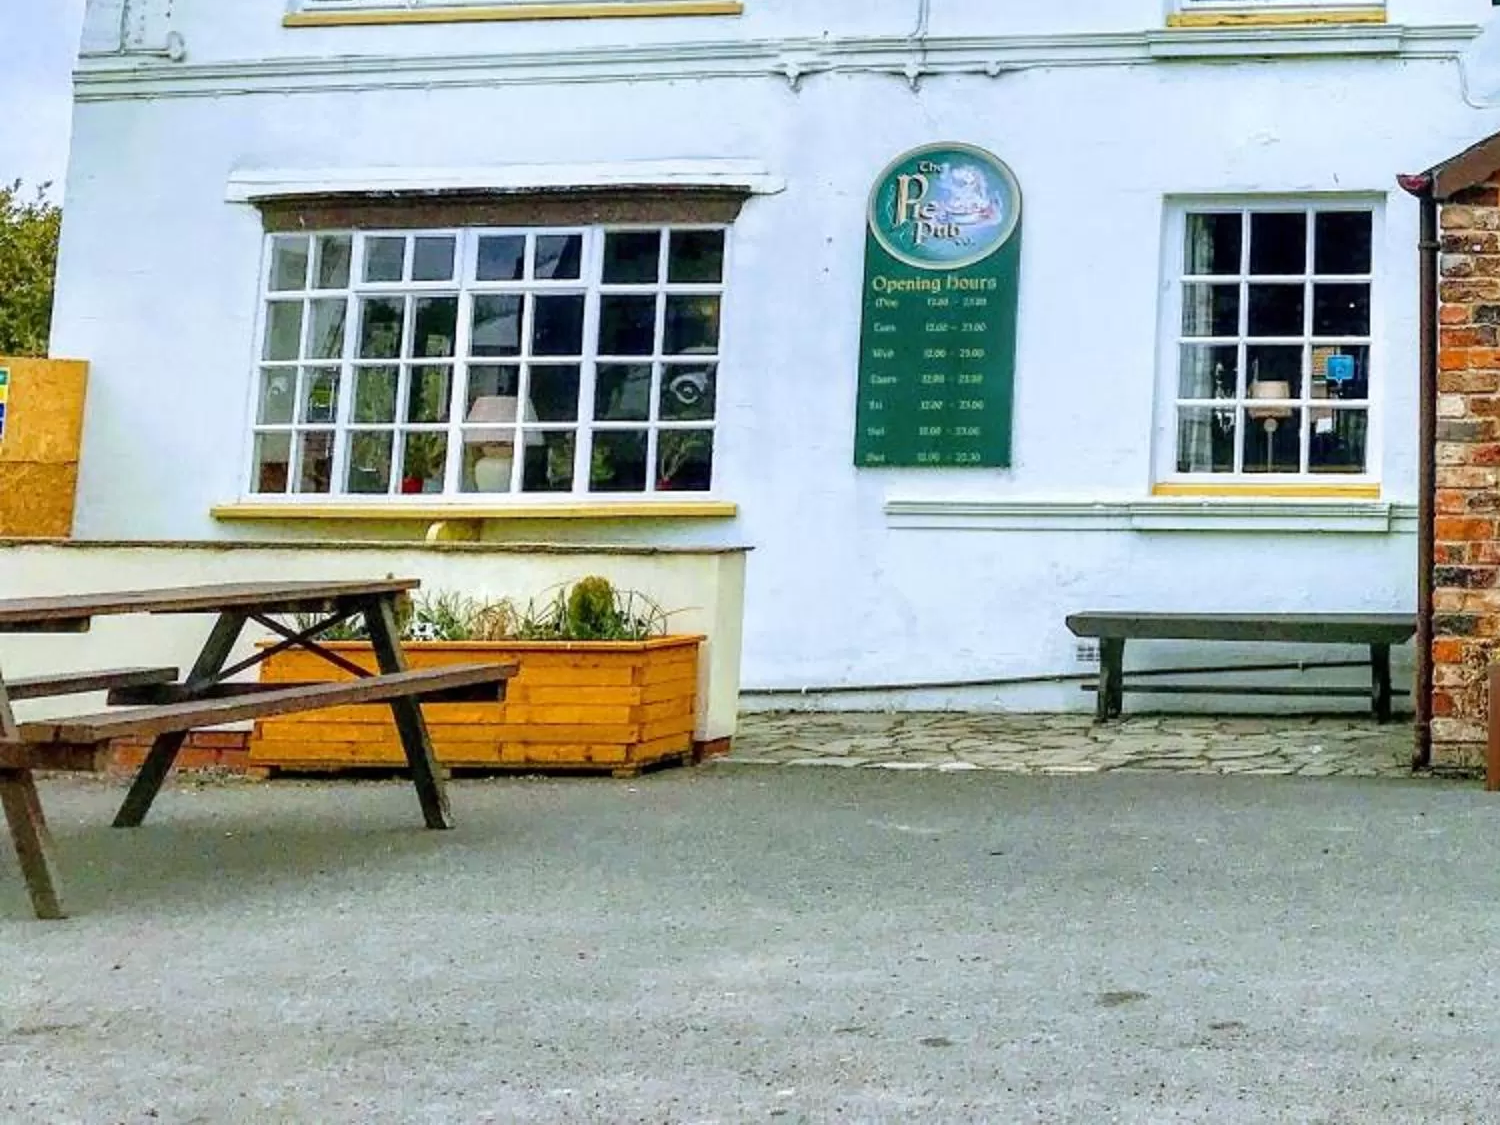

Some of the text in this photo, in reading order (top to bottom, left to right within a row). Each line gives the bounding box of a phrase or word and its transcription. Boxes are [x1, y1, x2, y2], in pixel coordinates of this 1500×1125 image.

[918, 160, 943, 174] The
[912, 221, 960, 245] Pub
[872, 275, 941, 294] Opening
